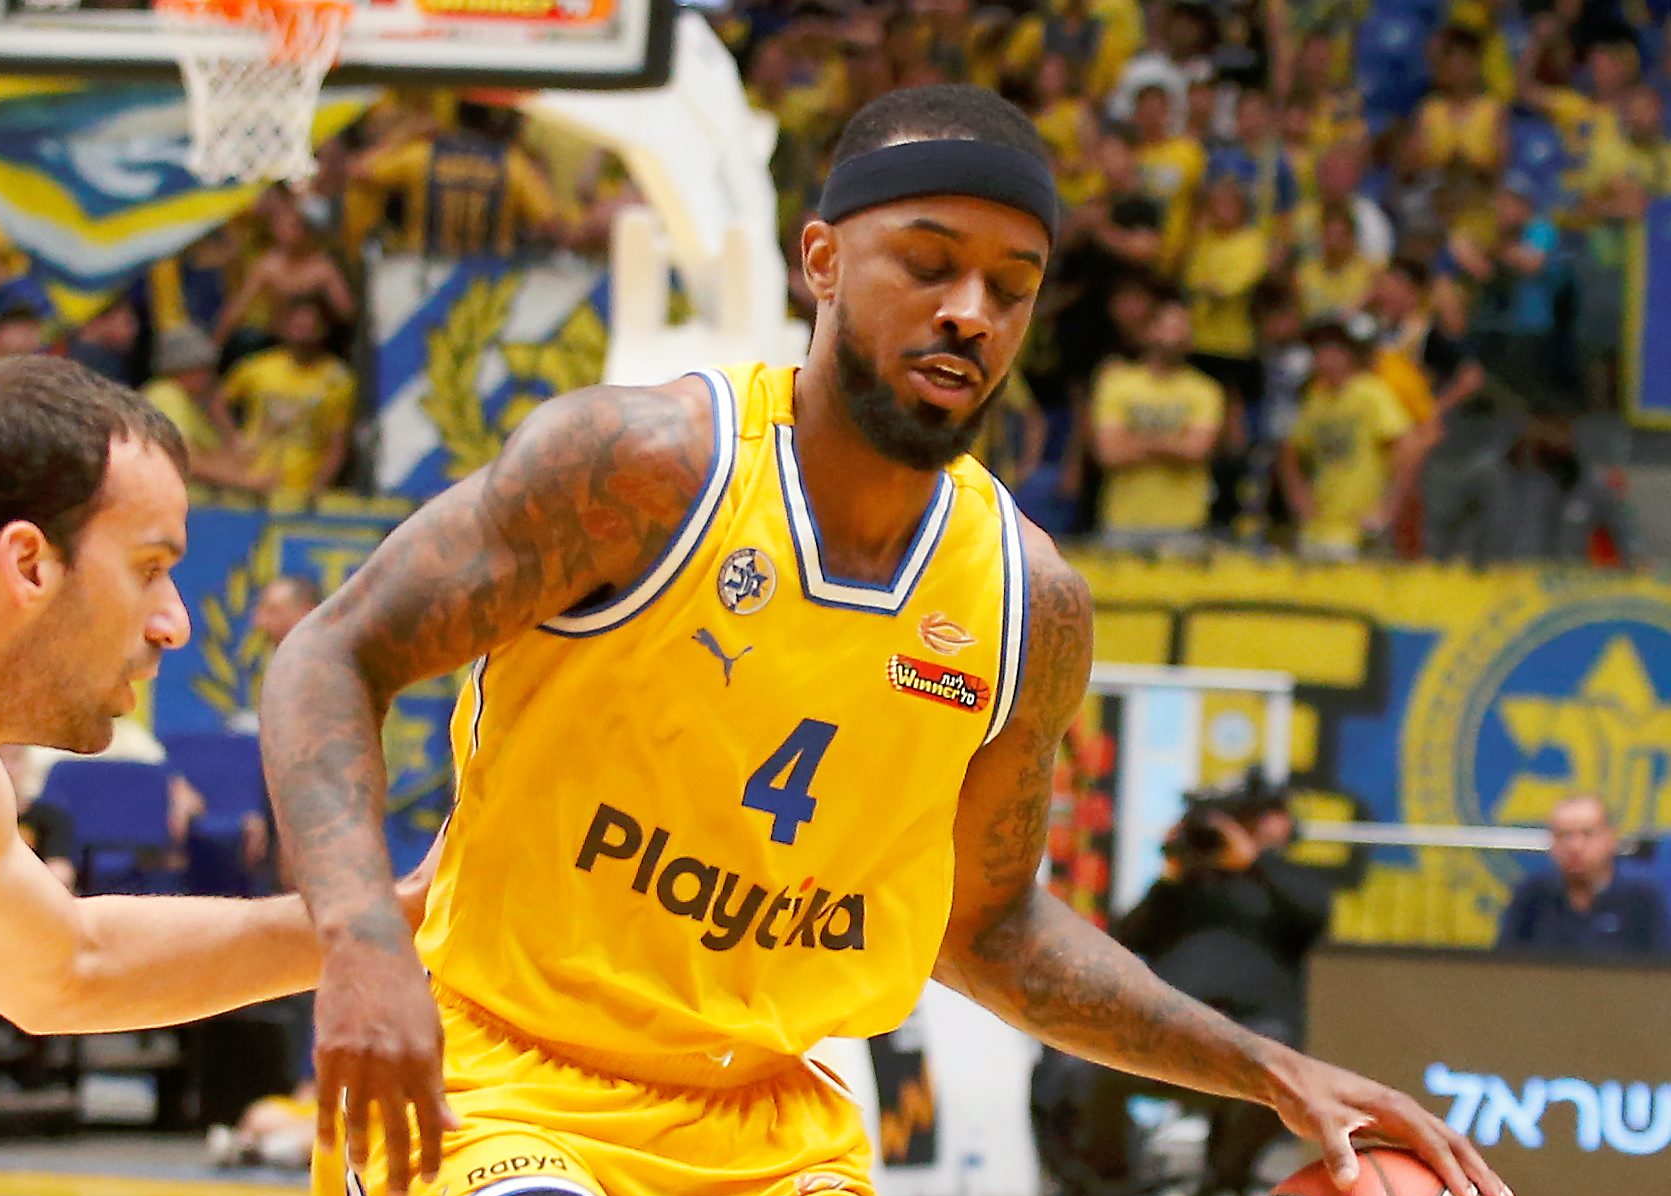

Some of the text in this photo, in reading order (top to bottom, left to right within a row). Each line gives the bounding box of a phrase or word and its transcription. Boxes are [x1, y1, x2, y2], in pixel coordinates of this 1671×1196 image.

[896, 664, 961, 701] Winner
[741, 717, 839, 845] 4
[575, 802, 865, 951] Playtika
[466, 1155, 568, 1186] Rapyd
